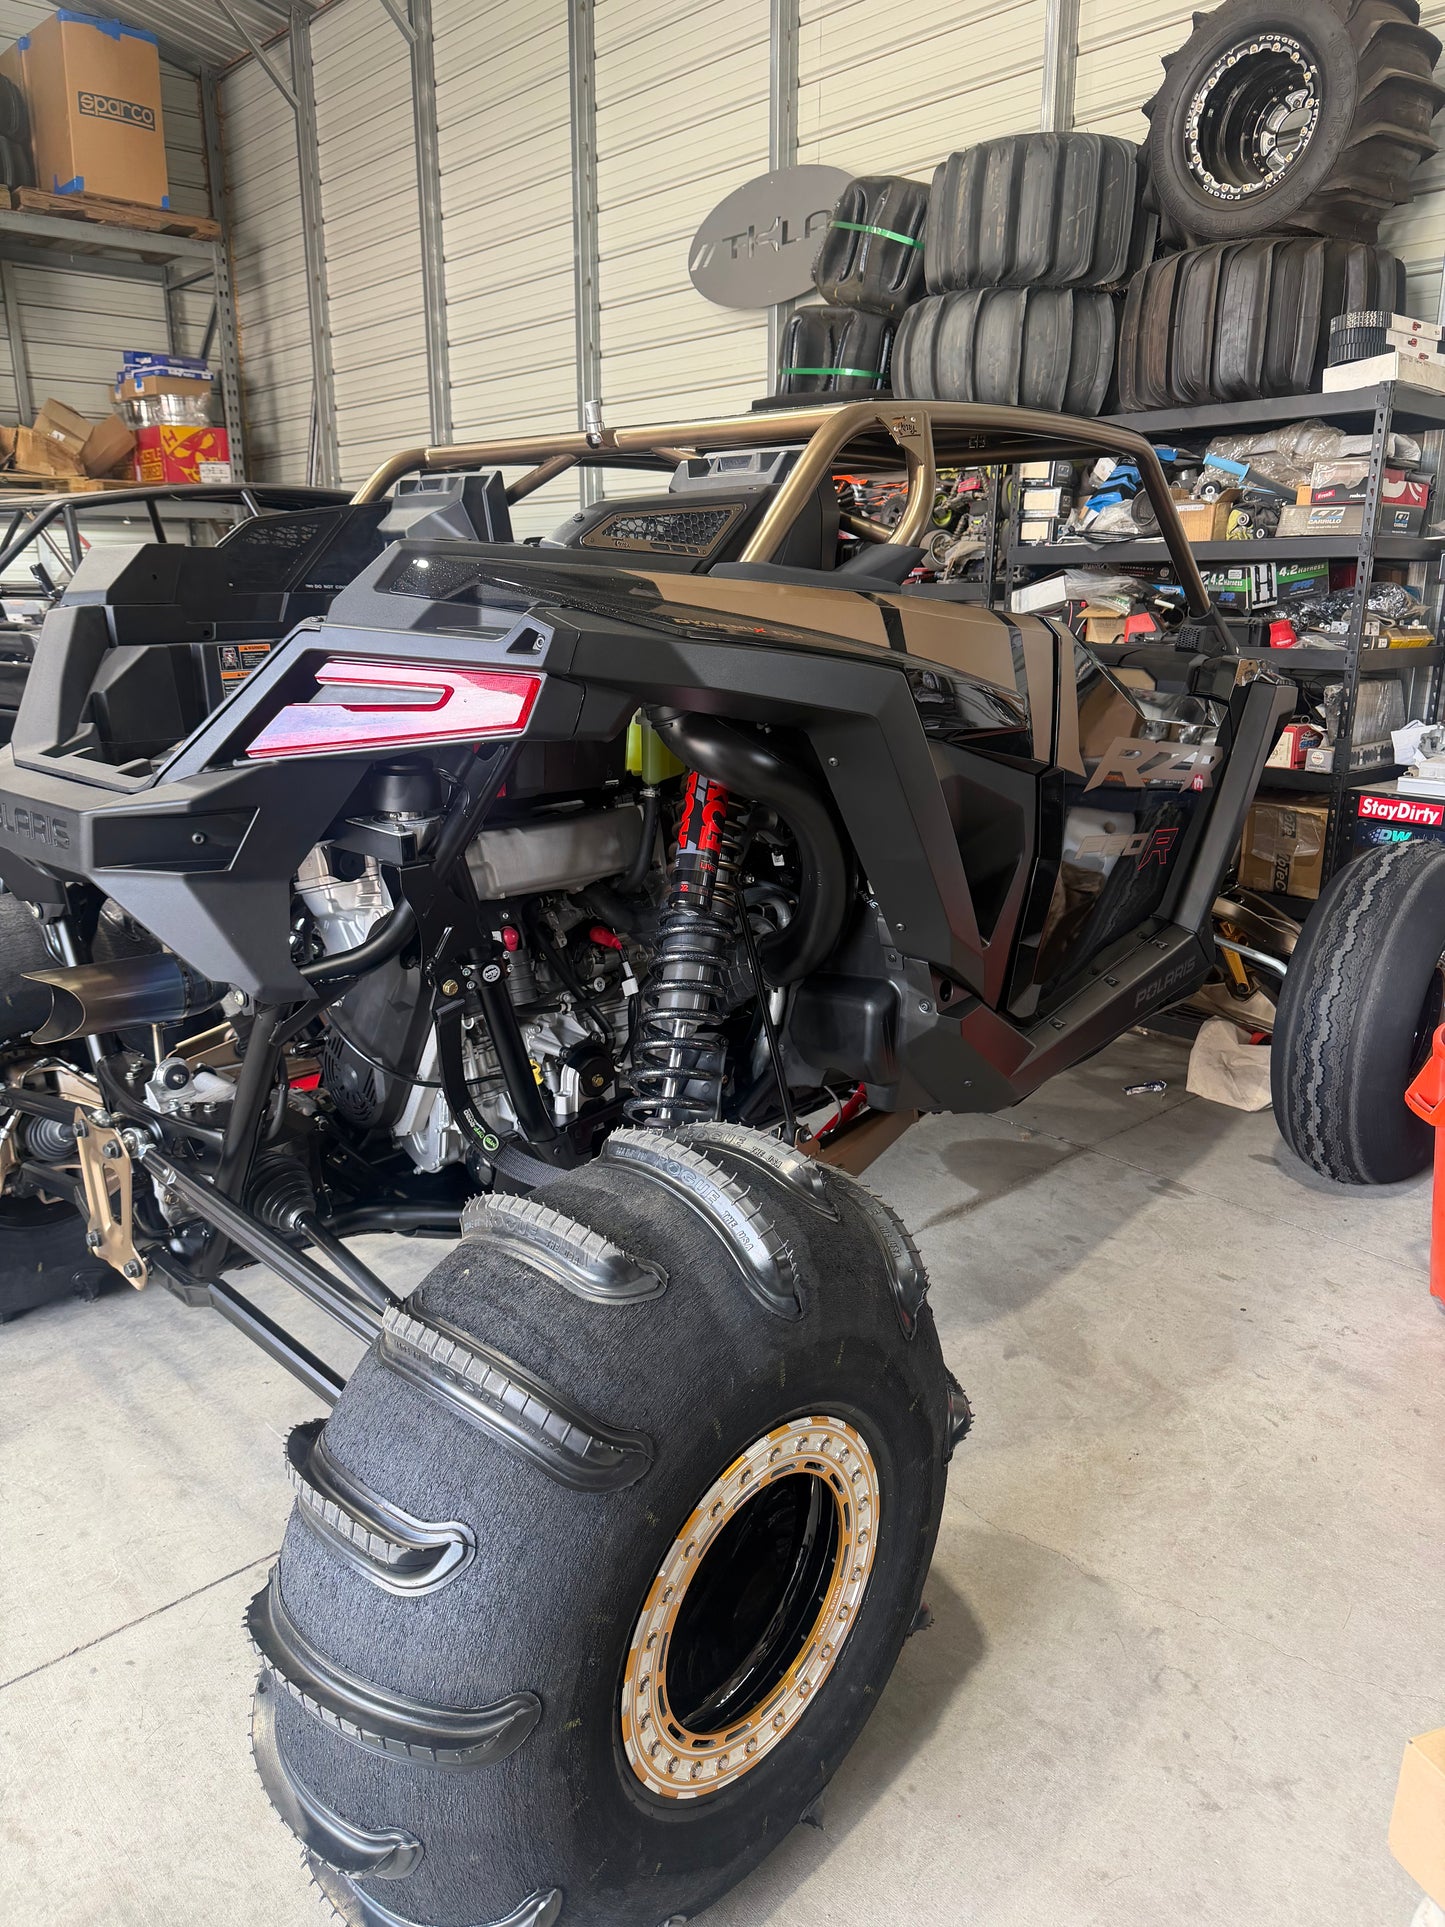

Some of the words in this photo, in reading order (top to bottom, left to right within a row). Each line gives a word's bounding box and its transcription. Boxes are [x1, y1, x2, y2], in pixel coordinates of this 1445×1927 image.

[1259, 35, 1300, 50] FORGED
[80, 94, 154, 124] sparco
[1303, 98, 1320, 147] KEIZER
[1202, 184, 1241, 200] FORGED
[1264, 171, 1287, 190] UTV
[1210, 574, 1224, 586] 4.2
[1224, 578, 1243, 587] Harness
[1279, 565, 1298, 577] 4.2
[1298, 563, 1325, 574] Harness
[1083, 737, 1223, 793] RZR
[0, 803, 70, 850] LARIS
[1361, 798, 1442, 825] StayDirty
[1137, 827, 1180, 871] R
[1379, 828, 1413, 842] DW
[1135, 955, 1197, 1009] POLARIS
[684, 1126, 747, 1148] ROGUE
[752, 1145, 766, 1158] THE
[767, 1155, 783, 1169] USA
[655, 1154, 721, 1206] ROGUE
[721, 1210, 738, 1230] THE
[736, 1230, 755, 1252] USA
